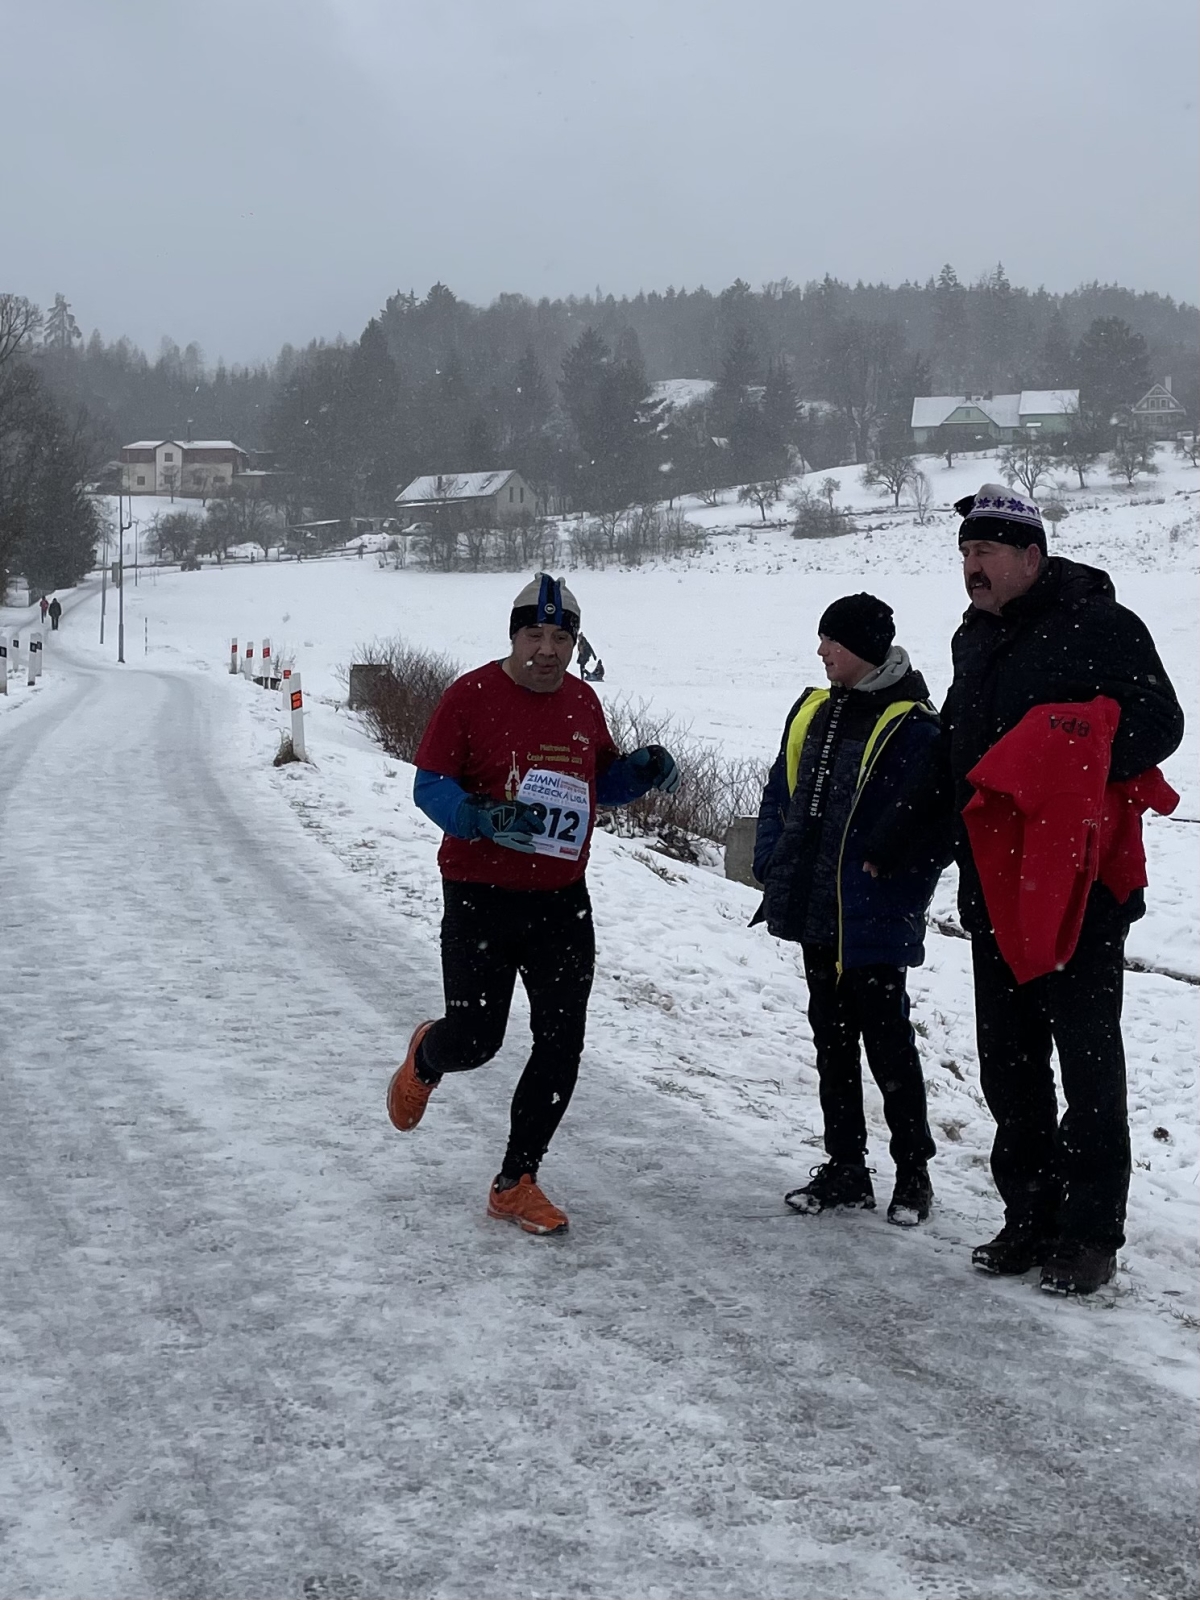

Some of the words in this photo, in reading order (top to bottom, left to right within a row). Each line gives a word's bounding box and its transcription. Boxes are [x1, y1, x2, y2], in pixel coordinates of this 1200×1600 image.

[830, 720, 838, 729] BE
[826, 731, 835, 743] NOT
[821, 745, 831, 759] CAN
[527, 774, 561, 788] ZIMNÍ
[815, 767, 826, 792] STREET
[570, 795, 588, 805] LIGA
[810, 793, 820, 817] CRAZY
